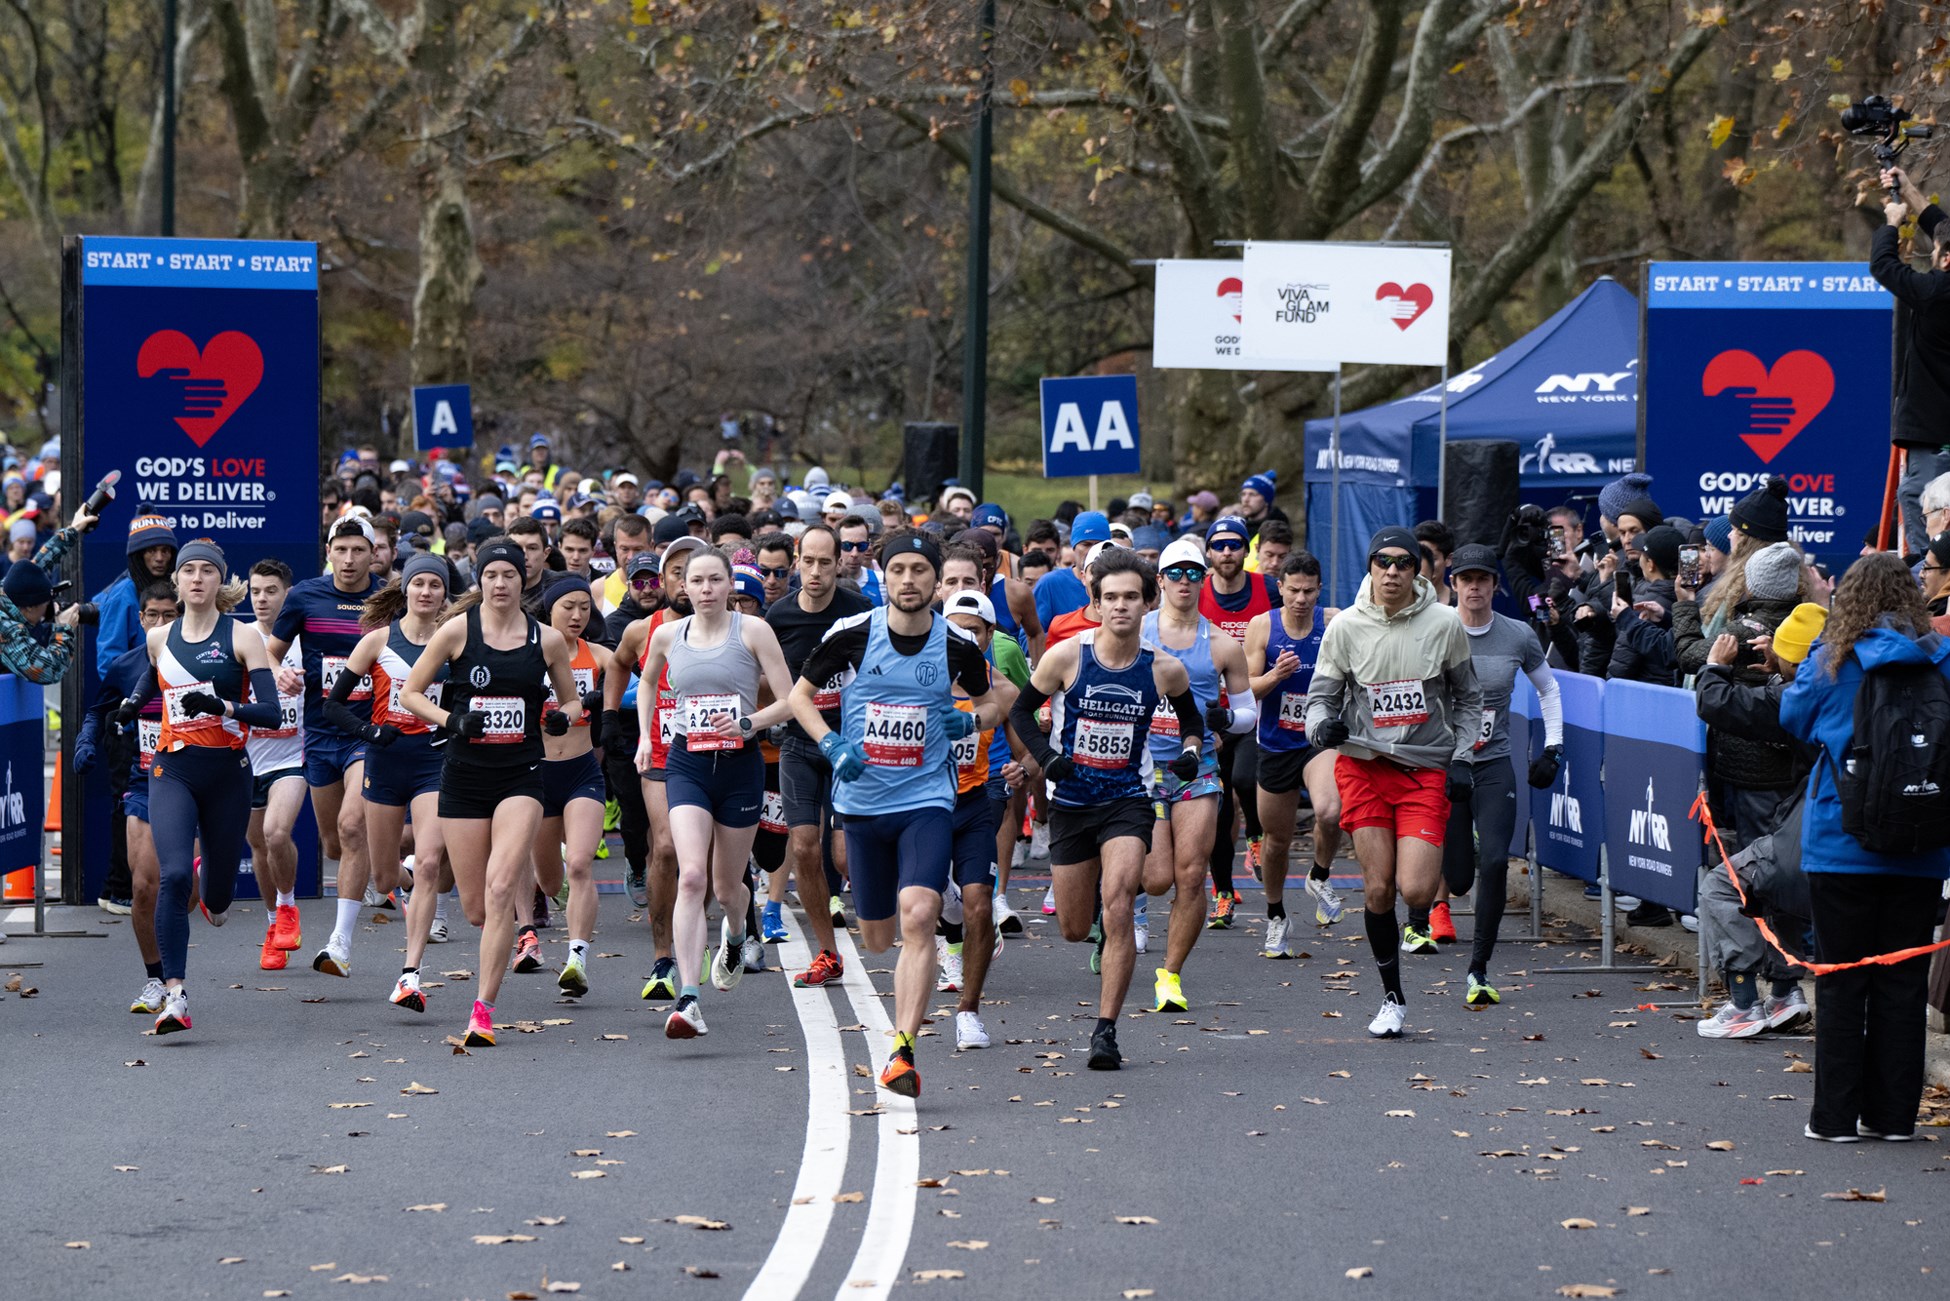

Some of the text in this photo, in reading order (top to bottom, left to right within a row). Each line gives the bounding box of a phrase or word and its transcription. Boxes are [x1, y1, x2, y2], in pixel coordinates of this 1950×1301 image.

[87, 252, 312, 272] START START START
[1654, 276, 1719, 292] START
[1737, 276, 1804, 292] START
[1278, 288, 1310, 300] VIVA
[1286, 300, 1329, 312] GLAM
[1276, 310, 1316, 323] FUND
[1215, 336, 1240, 344] GOD'
[1216, 347, 1231, 355] WE
[1537, 395, 1577, 403] NEW
[431, 400, 458, 435] A
[1049, 400, 1135, 453] AA
[136, 457, 265, 477] GOD'S LOVE
[1608, 458, 1637, 473] NE
[136, 482, 170, 501] WE
[1780, 474, 1835, 493] OVE
[181, 511, 266, 529] to Deliver
[1079, 698, 1146, 716] HELLGATE
[1373, 692, 1424, 712] A2432
[1105, 714, 1138, 722] RUNNERS
[866, 720, 925, 741] A4460
[722, 739, 737, 748] 2251
[1088, 735, 1131, 755] 5853
[900, 757, 917, 765] 4460
[1549, 792, 1583, 834] NYRR
[1629, 809, 1672, 852] NYRR
[1637, 857, 1646, 869] YORK
[1646, 859, 1656, 871] ROAD
[1656, 861, 1672, 876] RUNNERS
